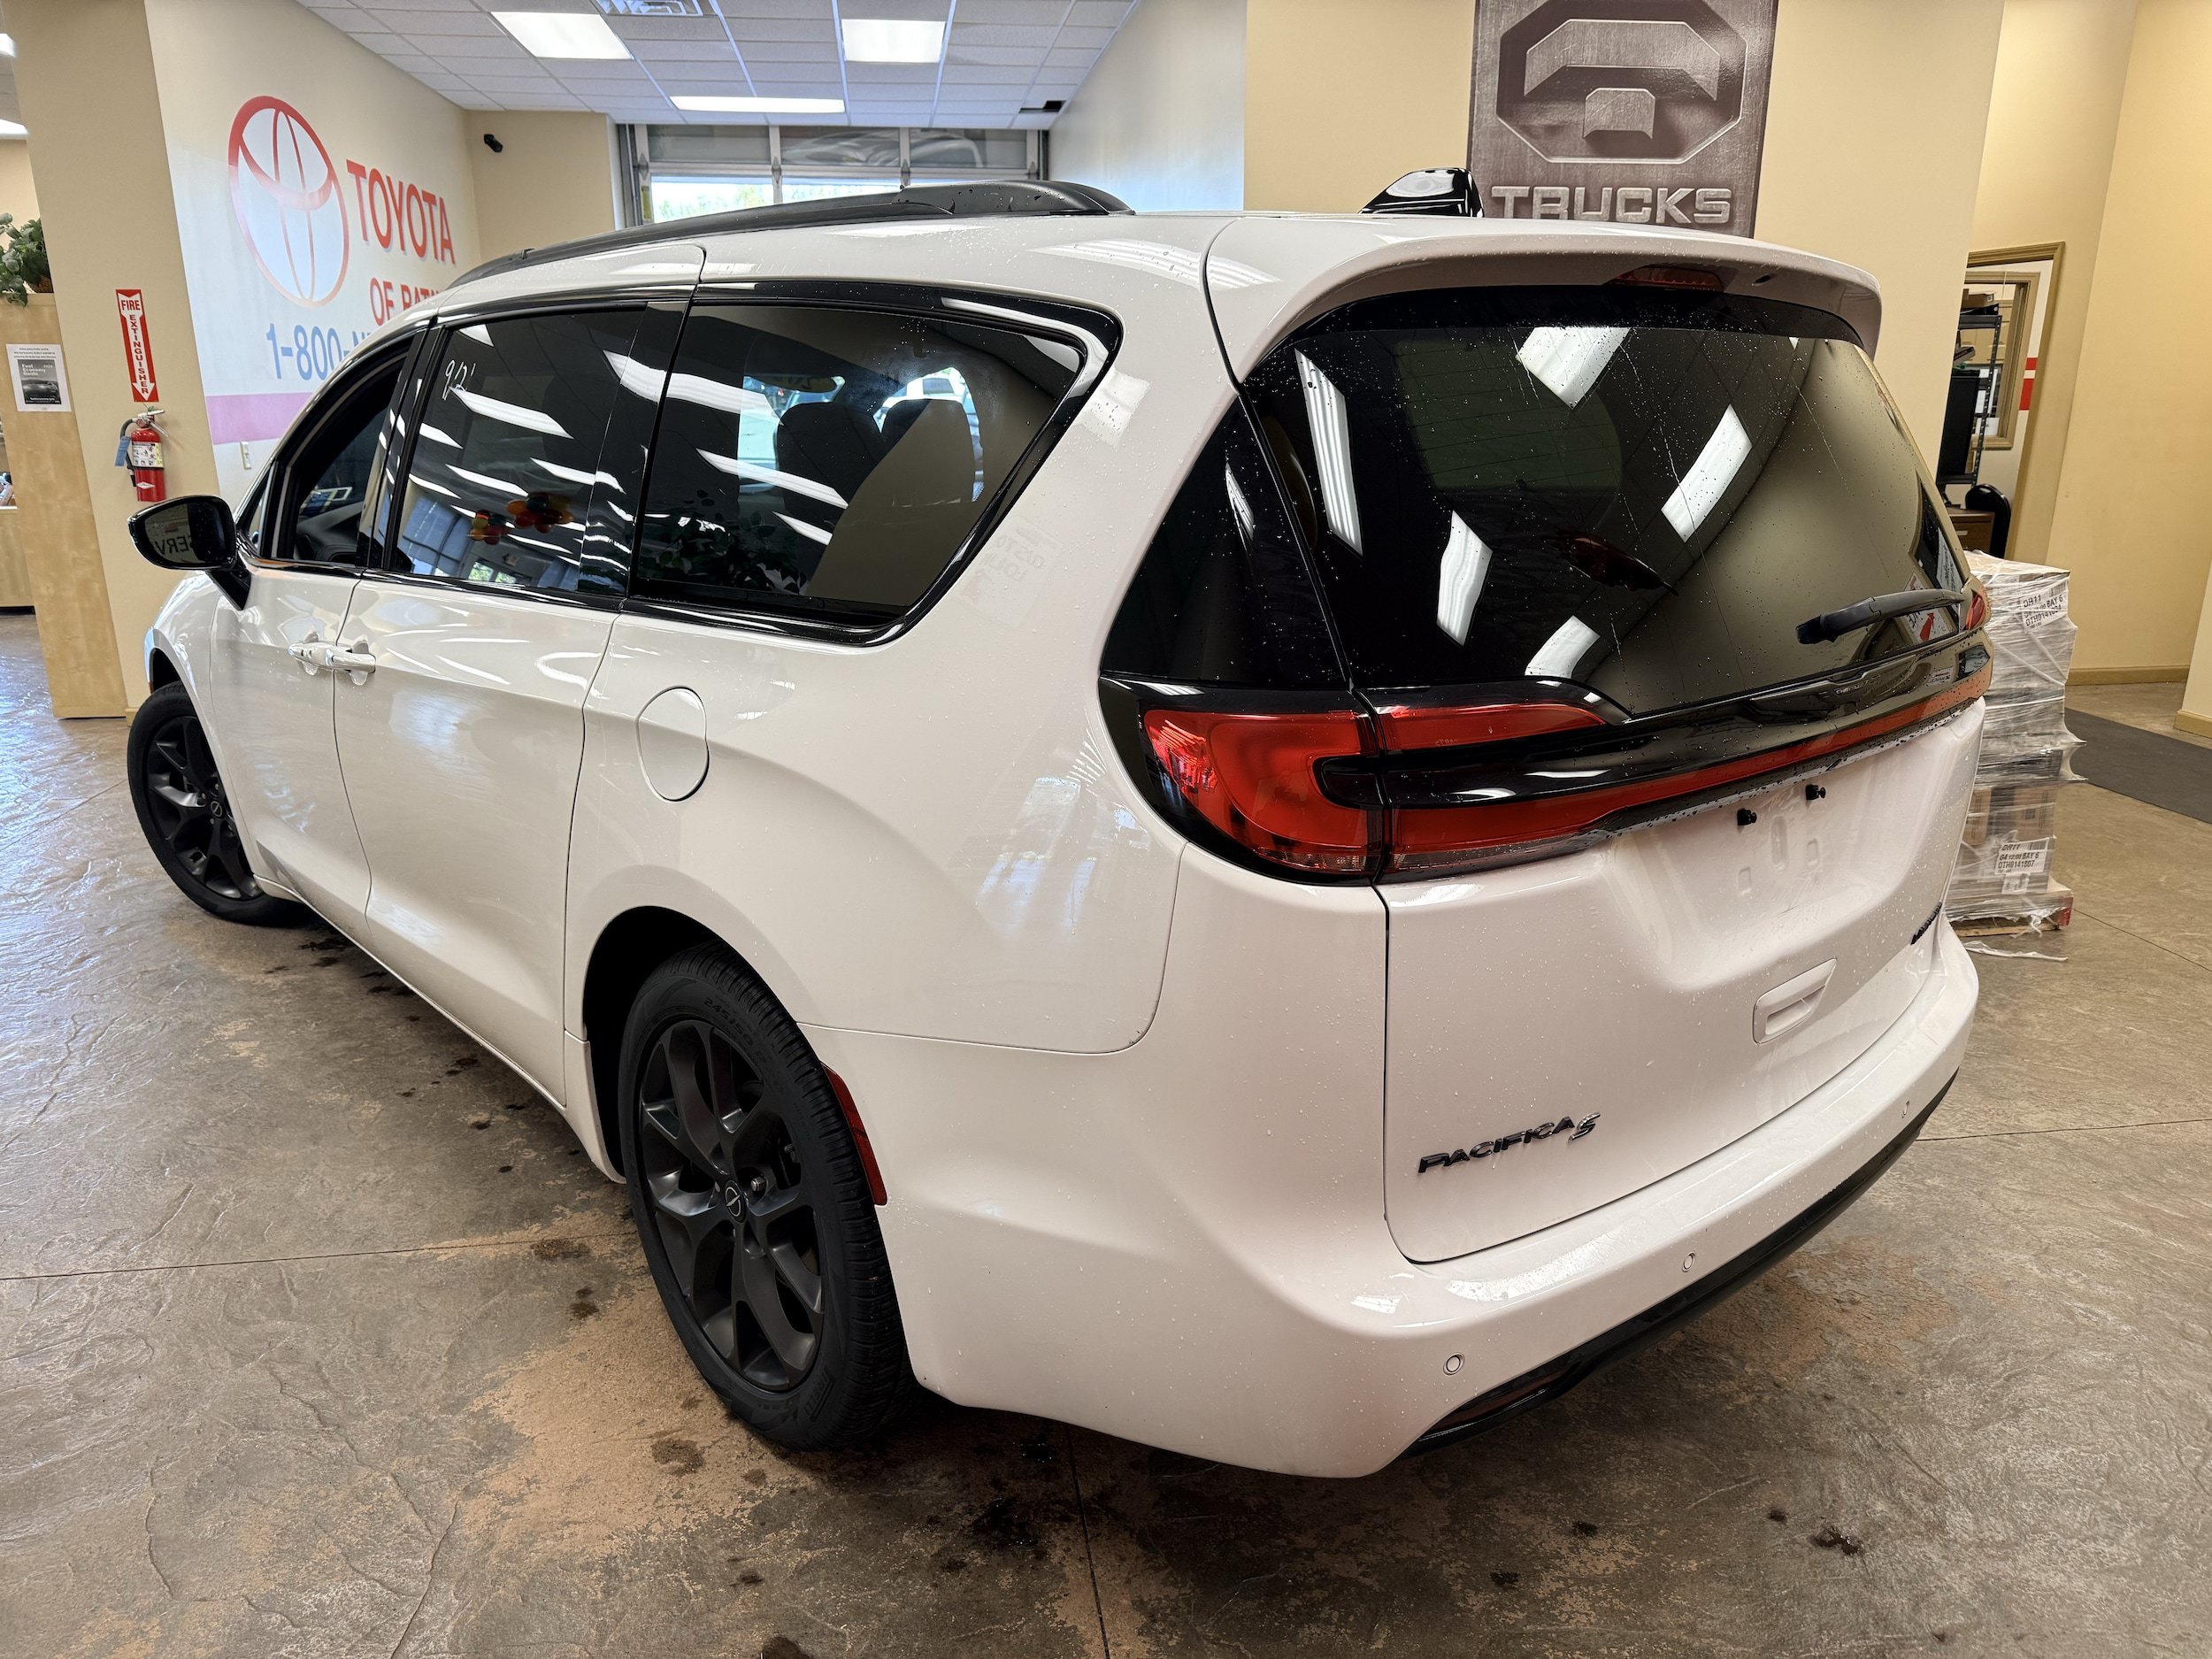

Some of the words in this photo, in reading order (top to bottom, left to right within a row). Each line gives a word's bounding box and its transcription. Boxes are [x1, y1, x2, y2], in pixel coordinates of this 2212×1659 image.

[346, 158, 456, 265] TOYOTA
[1491, 186, 1732, 223] TRUCKS
[121, 300, 141, 311] FIRE
[370, 277, 395, 326] OF
[129, 314, 149, 394] EXTINGUISHER
[2047, 596, 2058, 607] BAY
[2059, 594, 2063, 603] 6
[1417, 1116, 1575, 1174] PACIFICA
[1568, 1111, 1601, 1141] S
